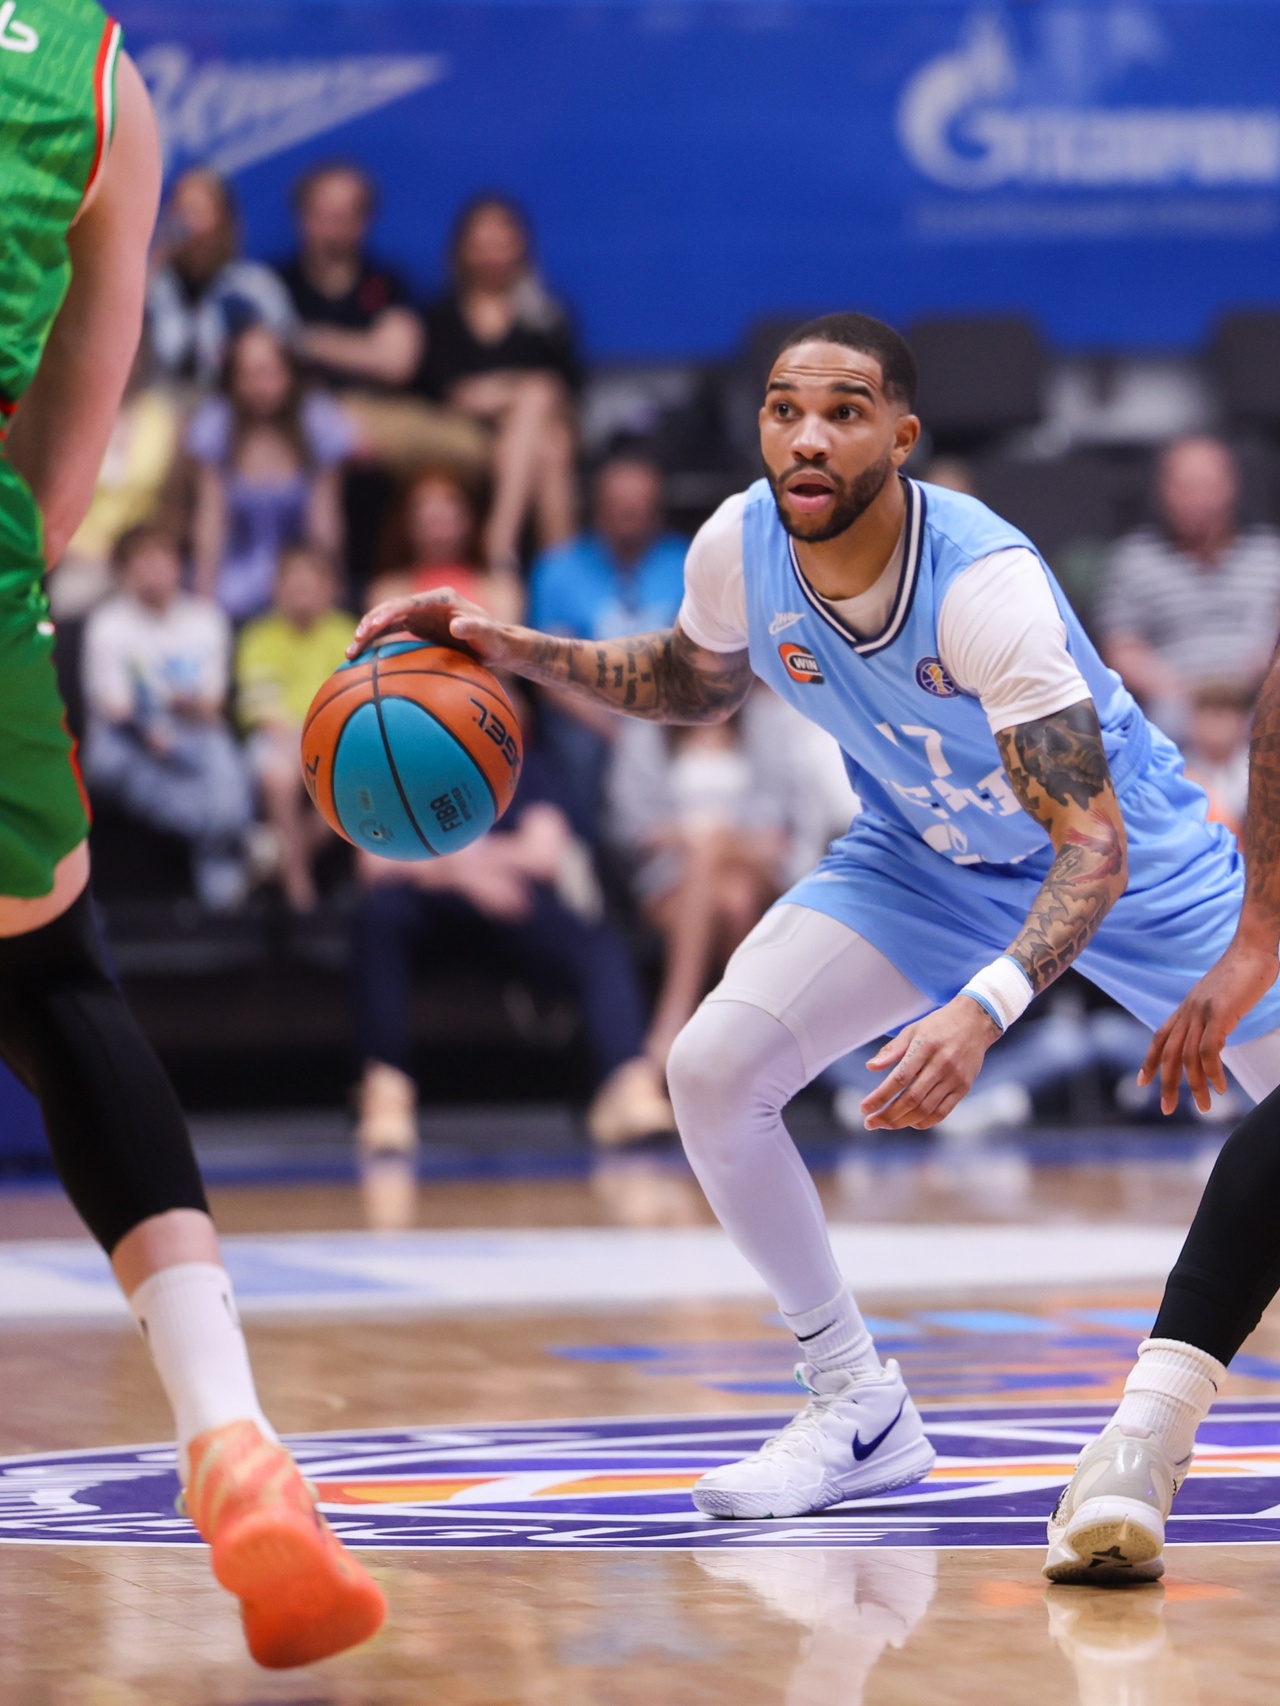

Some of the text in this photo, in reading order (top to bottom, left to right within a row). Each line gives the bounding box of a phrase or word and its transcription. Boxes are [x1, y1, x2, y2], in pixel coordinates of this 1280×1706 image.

[792, 656, 819, 671] WIN
[468, 695, 520, 772] GEL
[430, 793, 463, 833] FIBA
[0, 1511, 887, 1544] LEGUE
